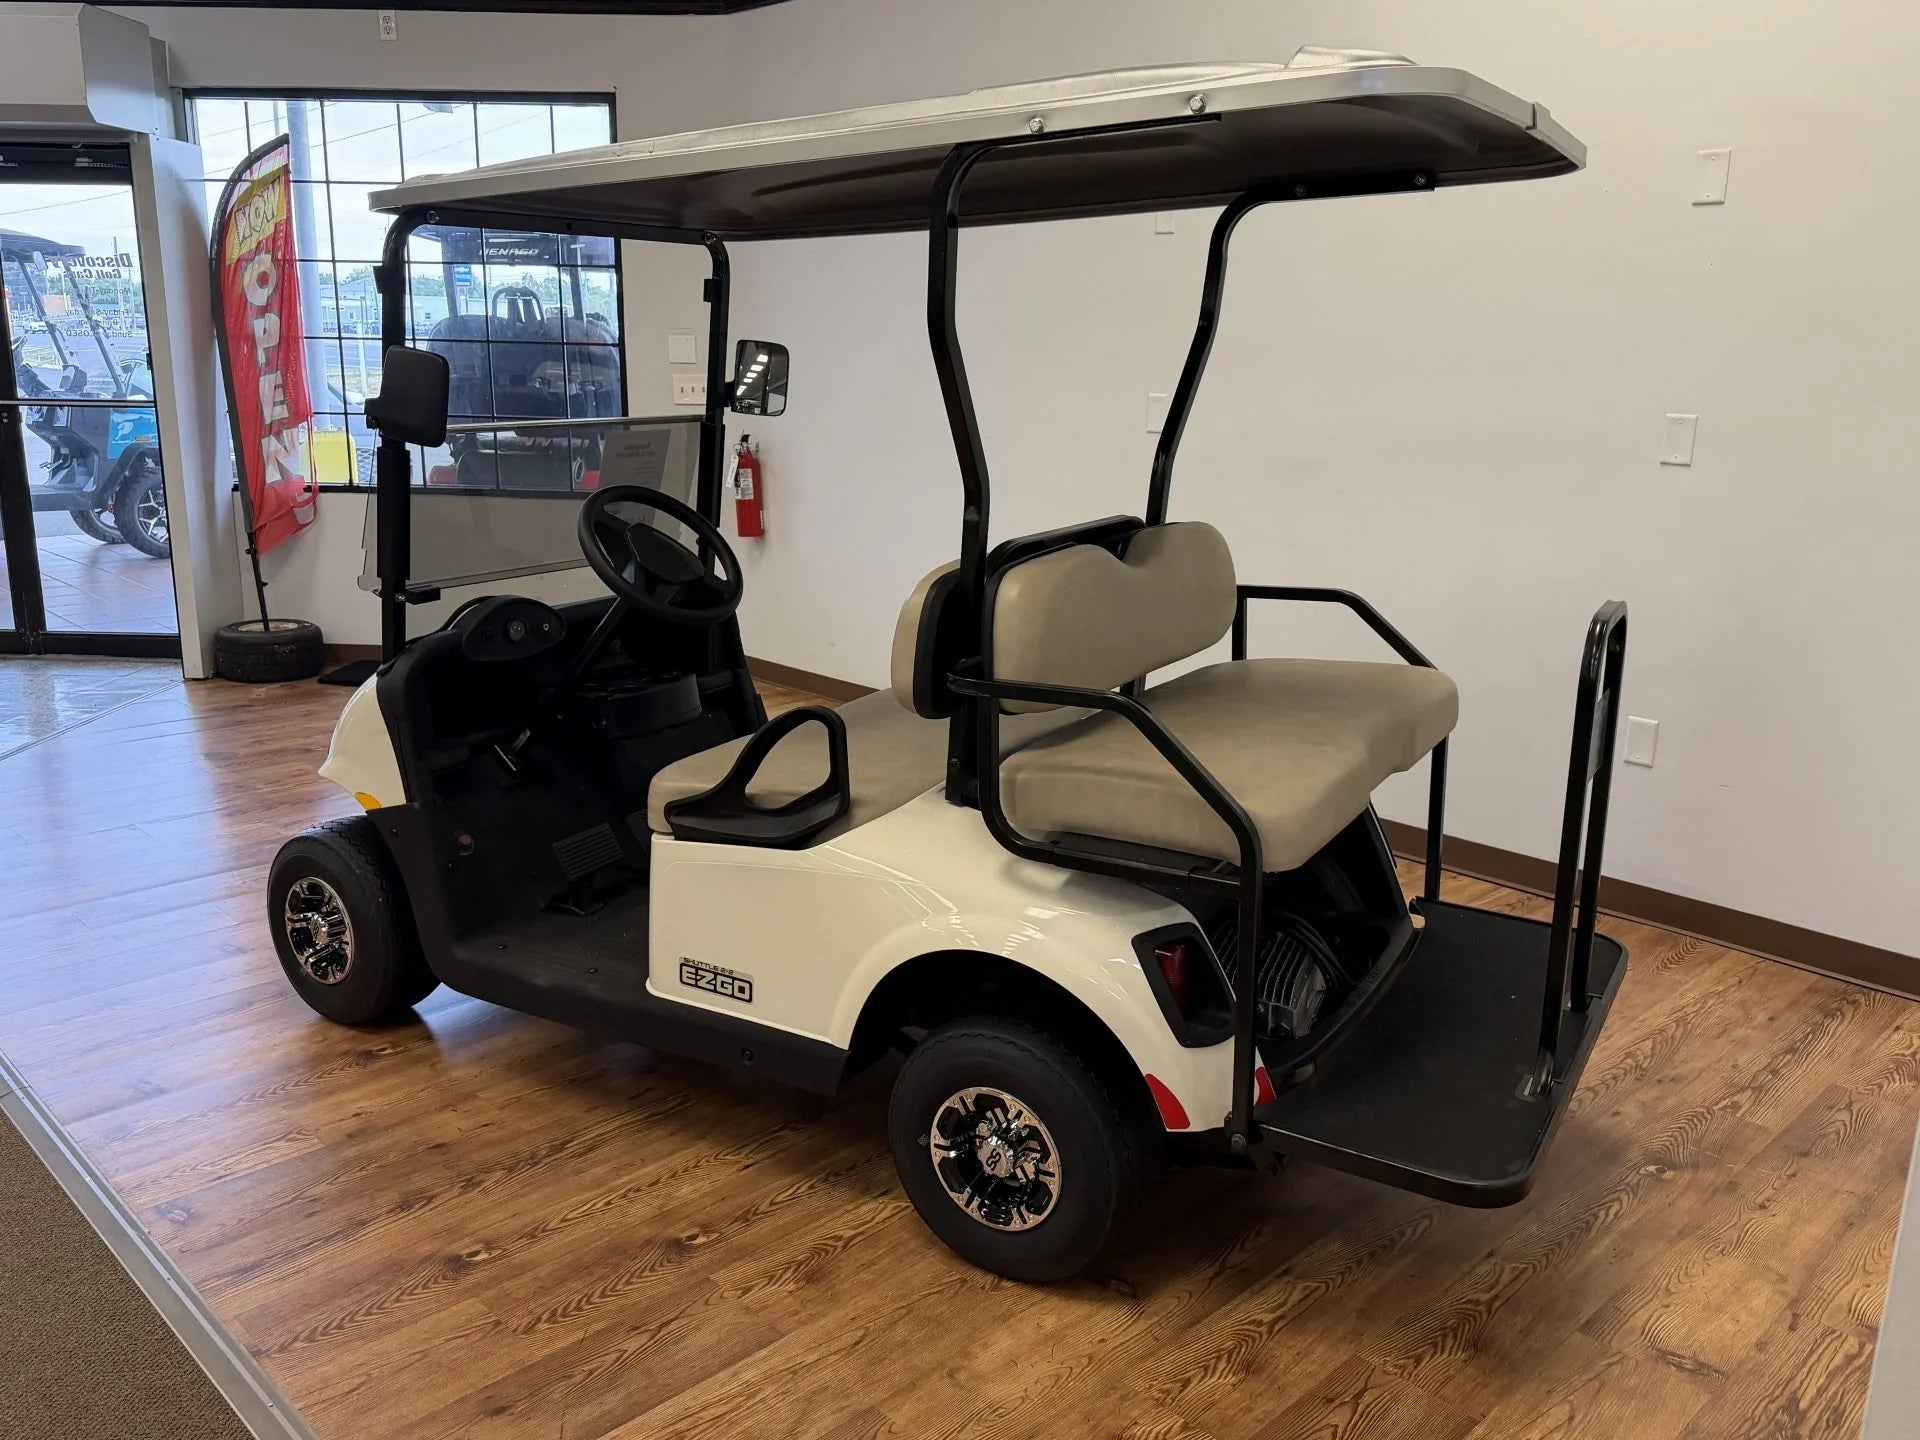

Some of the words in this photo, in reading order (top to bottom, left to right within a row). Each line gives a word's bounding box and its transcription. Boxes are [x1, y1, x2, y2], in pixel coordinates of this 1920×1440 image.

[243, 252, 305, 485] OPEN
[683, 957, 719, 971] SHUTTLE
[681, 965, 751, 1001] EZGO
